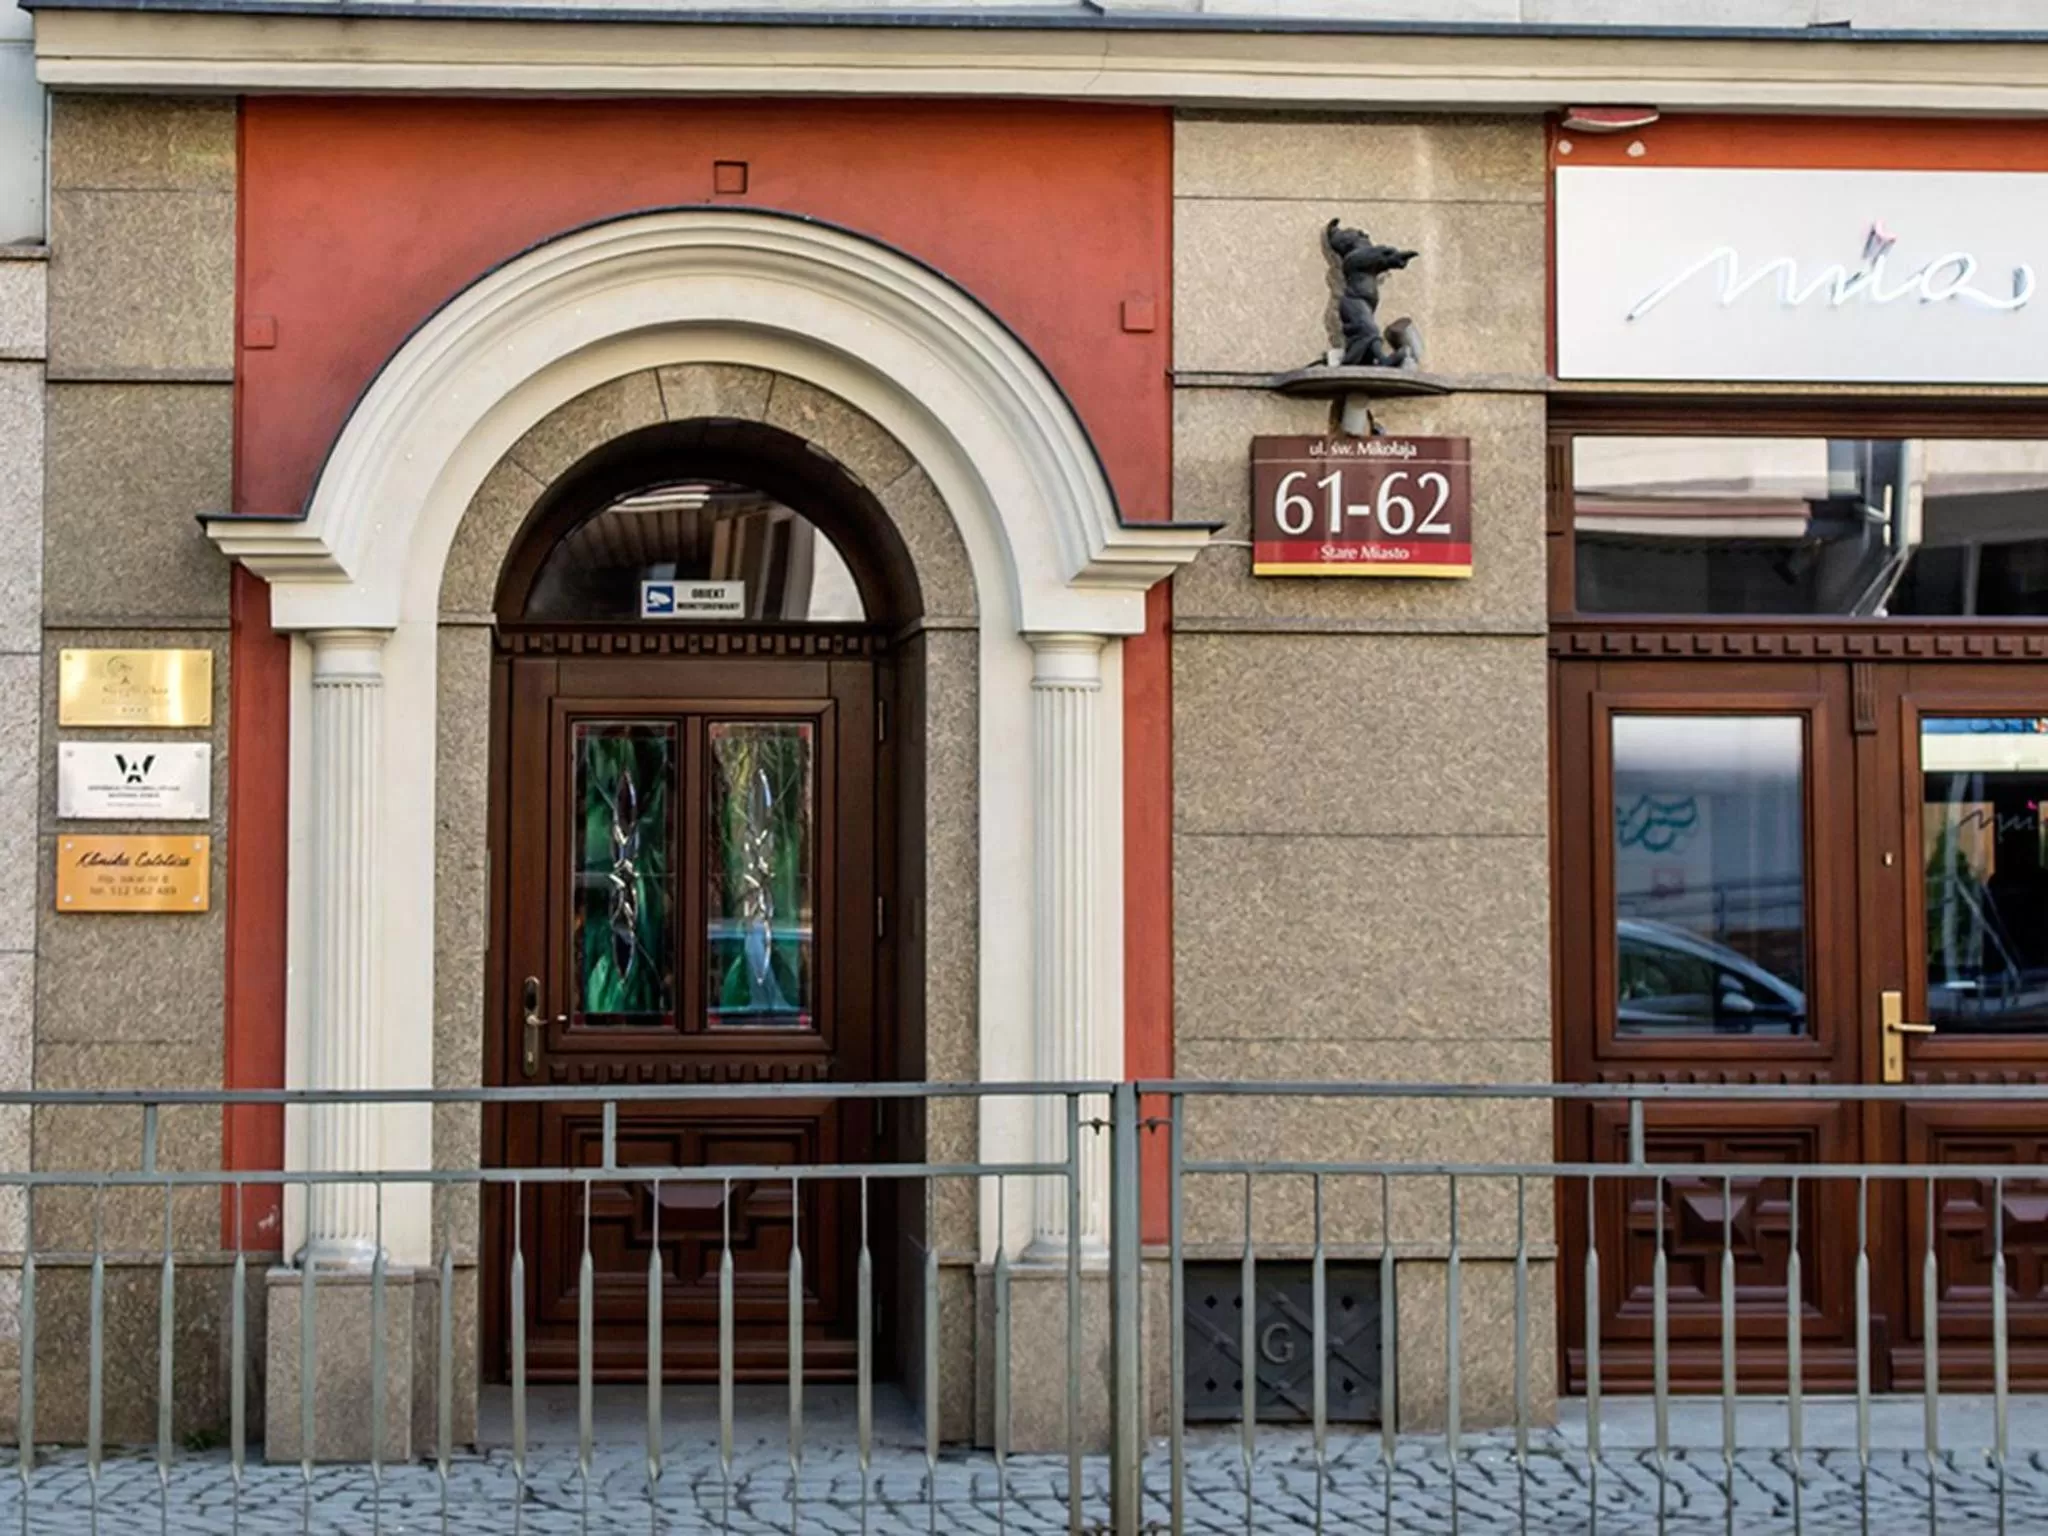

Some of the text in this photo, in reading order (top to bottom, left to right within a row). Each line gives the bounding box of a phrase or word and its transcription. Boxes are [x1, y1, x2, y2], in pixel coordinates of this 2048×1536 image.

[1309, 440, 1327, 456] ul.
[1357, 440, 1417, 460] Mikołaja
[1273, 469, 1452, 536] 61-62
[1321, 545, 1410, 560] Stare Miasto
[691, 588, 726, 599] OBIEKT
[1260, 1322, 1295, 1365] G
